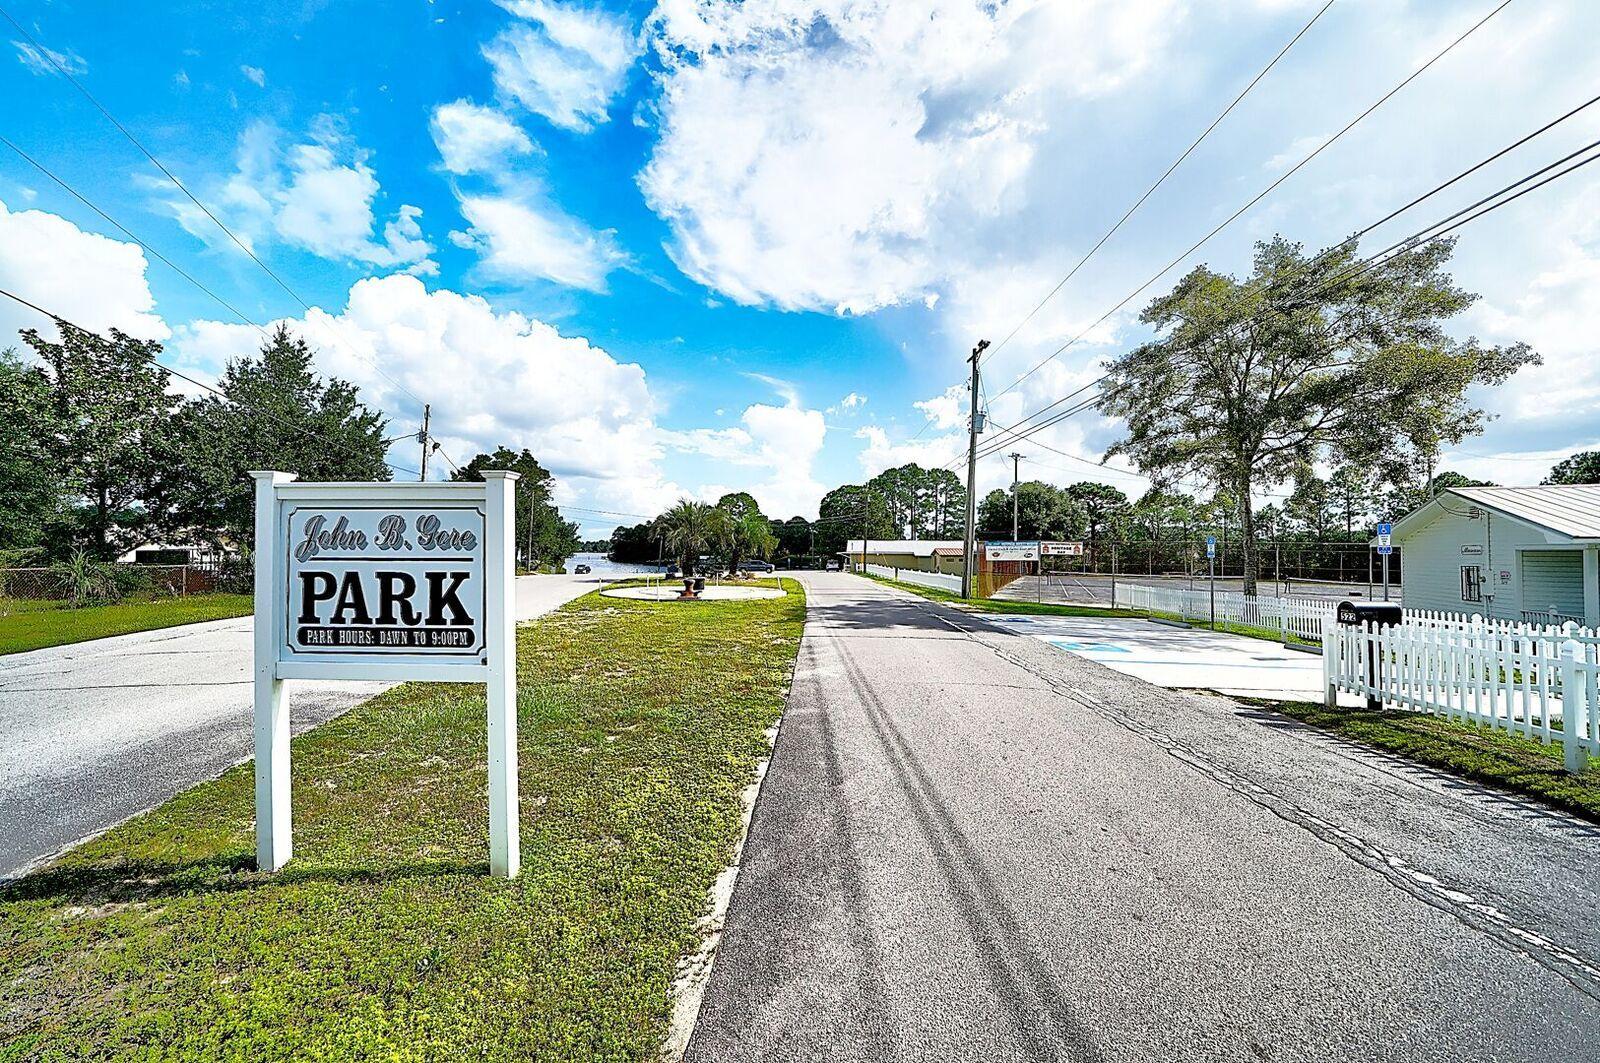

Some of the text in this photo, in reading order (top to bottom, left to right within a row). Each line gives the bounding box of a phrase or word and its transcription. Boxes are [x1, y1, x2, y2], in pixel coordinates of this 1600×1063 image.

[294, 514, 478, 563] John B. Gore
[297, 571, 475, 627] PARK
[306, 629, 468, 646] PARK HOURS: DAWN TO 9:00PM
